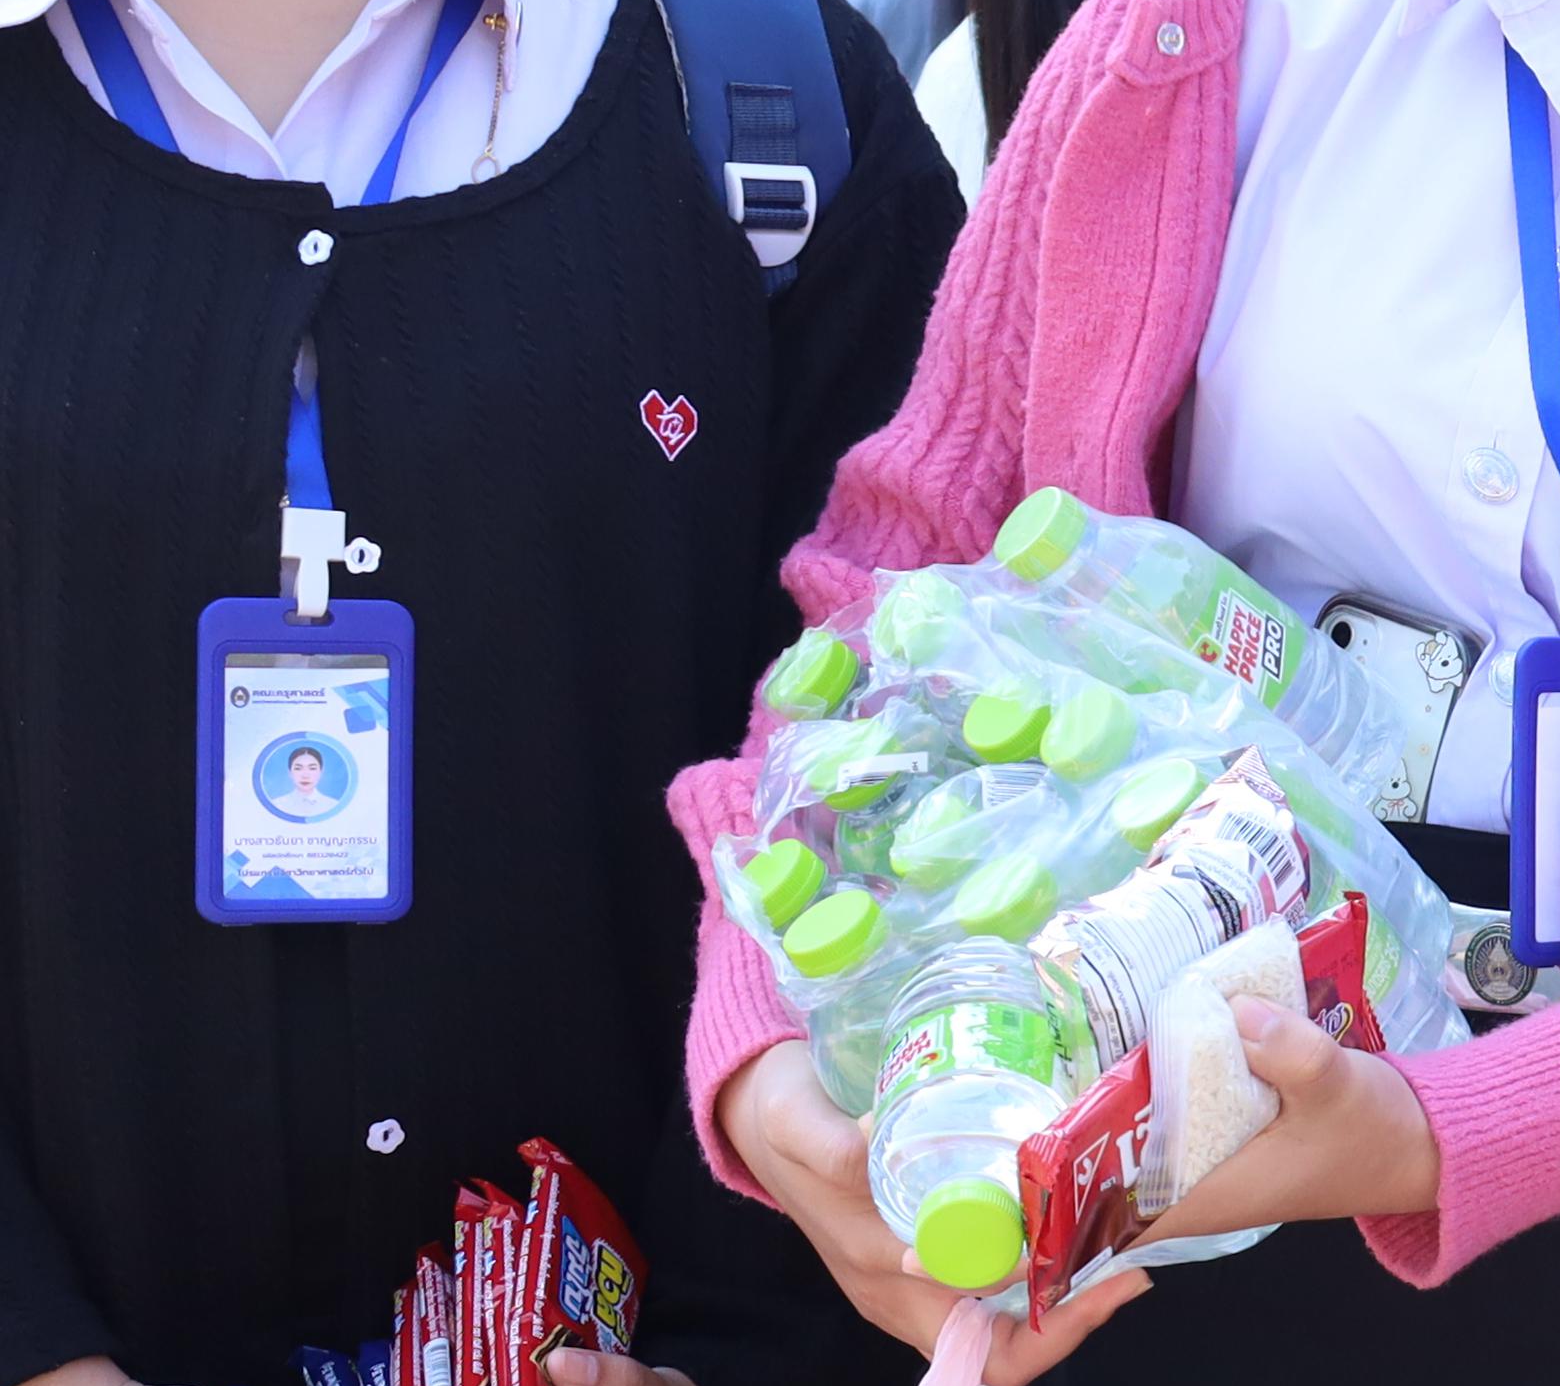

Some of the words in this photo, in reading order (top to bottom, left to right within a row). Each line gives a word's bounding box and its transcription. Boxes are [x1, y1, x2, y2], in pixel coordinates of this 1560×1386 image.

[1224, 605, 1247, 676] HAPPY
[1238, 612, 1262, 684] PRICE
[1263, 619, 1282, 675] PRO
